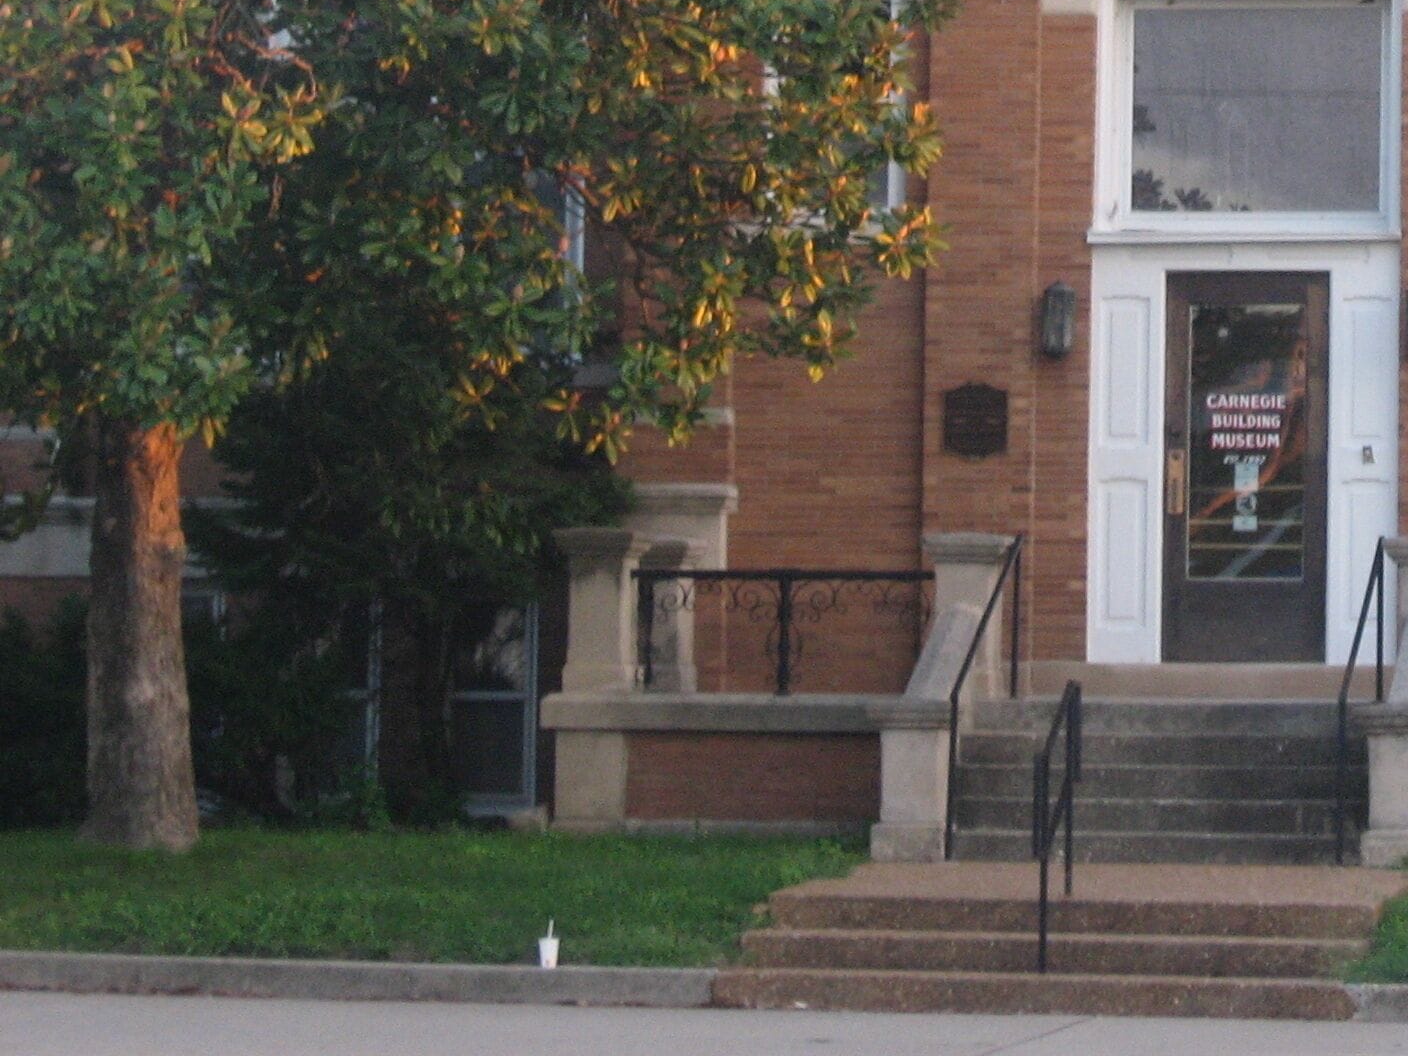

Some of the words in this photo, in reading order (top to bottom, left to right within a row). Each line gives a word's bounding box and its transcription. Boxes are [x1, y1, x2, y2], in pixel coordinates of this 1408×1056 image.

[1206, 394, 1286, 410] CARNEGIE
[1211, 414, 1281, 429] BUILDING
[1211, 433, 1281, 449] MUSEUM
